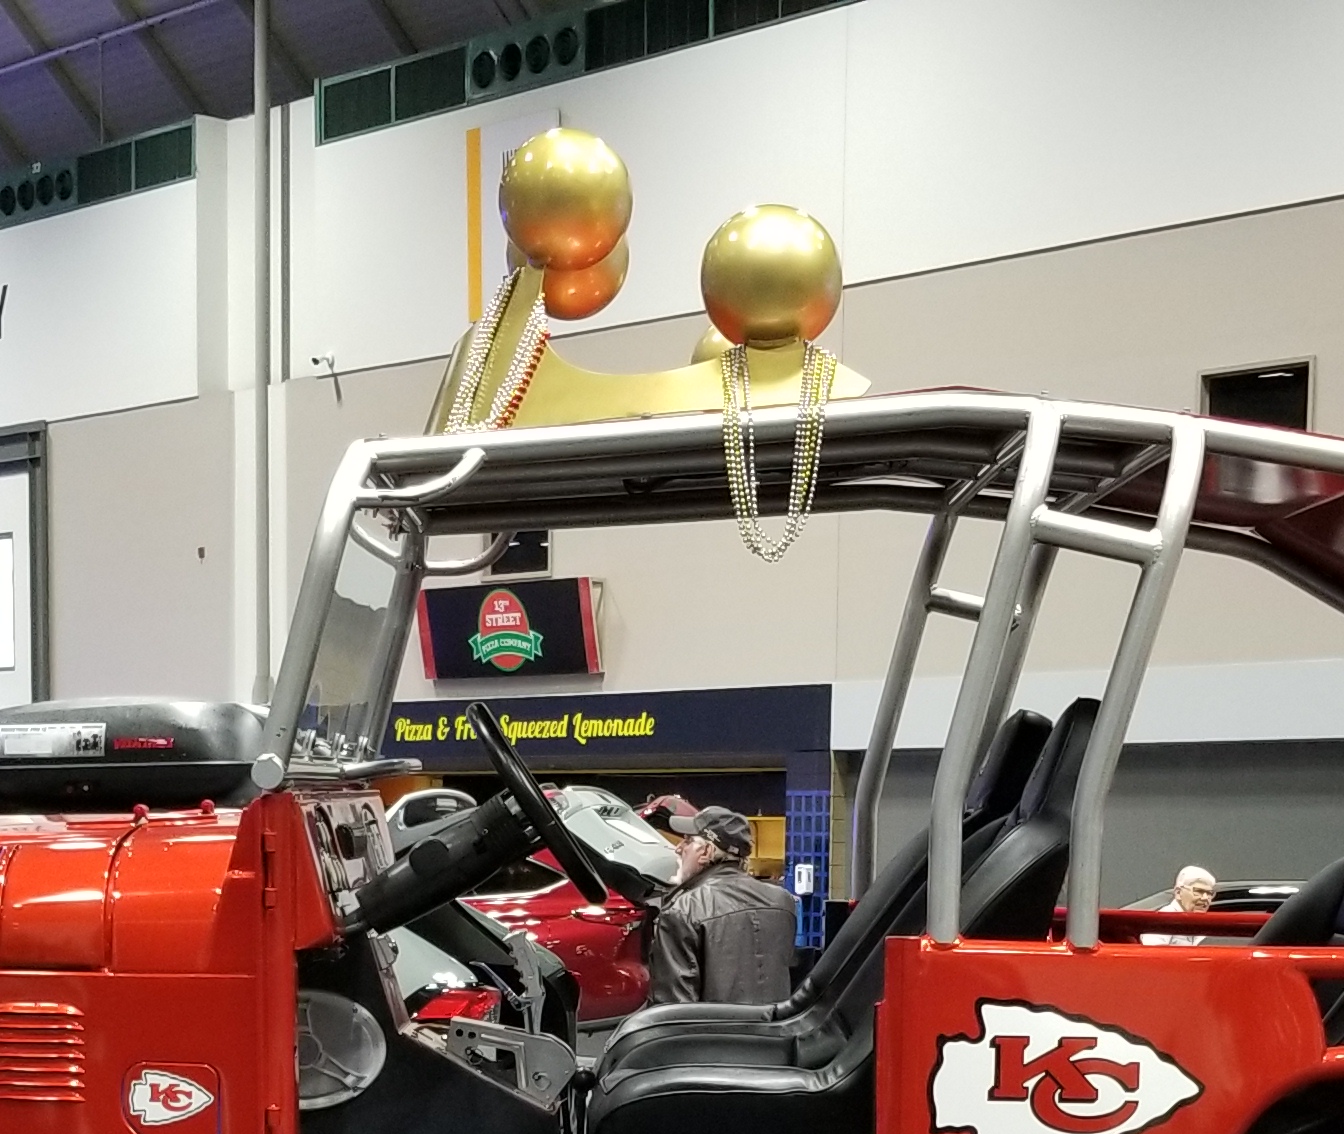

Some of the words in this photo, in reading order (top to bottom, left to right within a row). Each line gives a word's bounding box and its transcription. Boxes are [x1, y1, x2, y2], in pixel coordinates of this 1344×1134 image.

[485, 612, 522, 627] STREET
[395, 718, 433, 741] Pizza
[436, 716, 451, 738] &
[500, 710, 570, 746] Squeezed
[572, 711, 656, 745] Lemonade
[149, 1083, 192, 1112] KC
[986, 1035, 1141, 1134] KC
